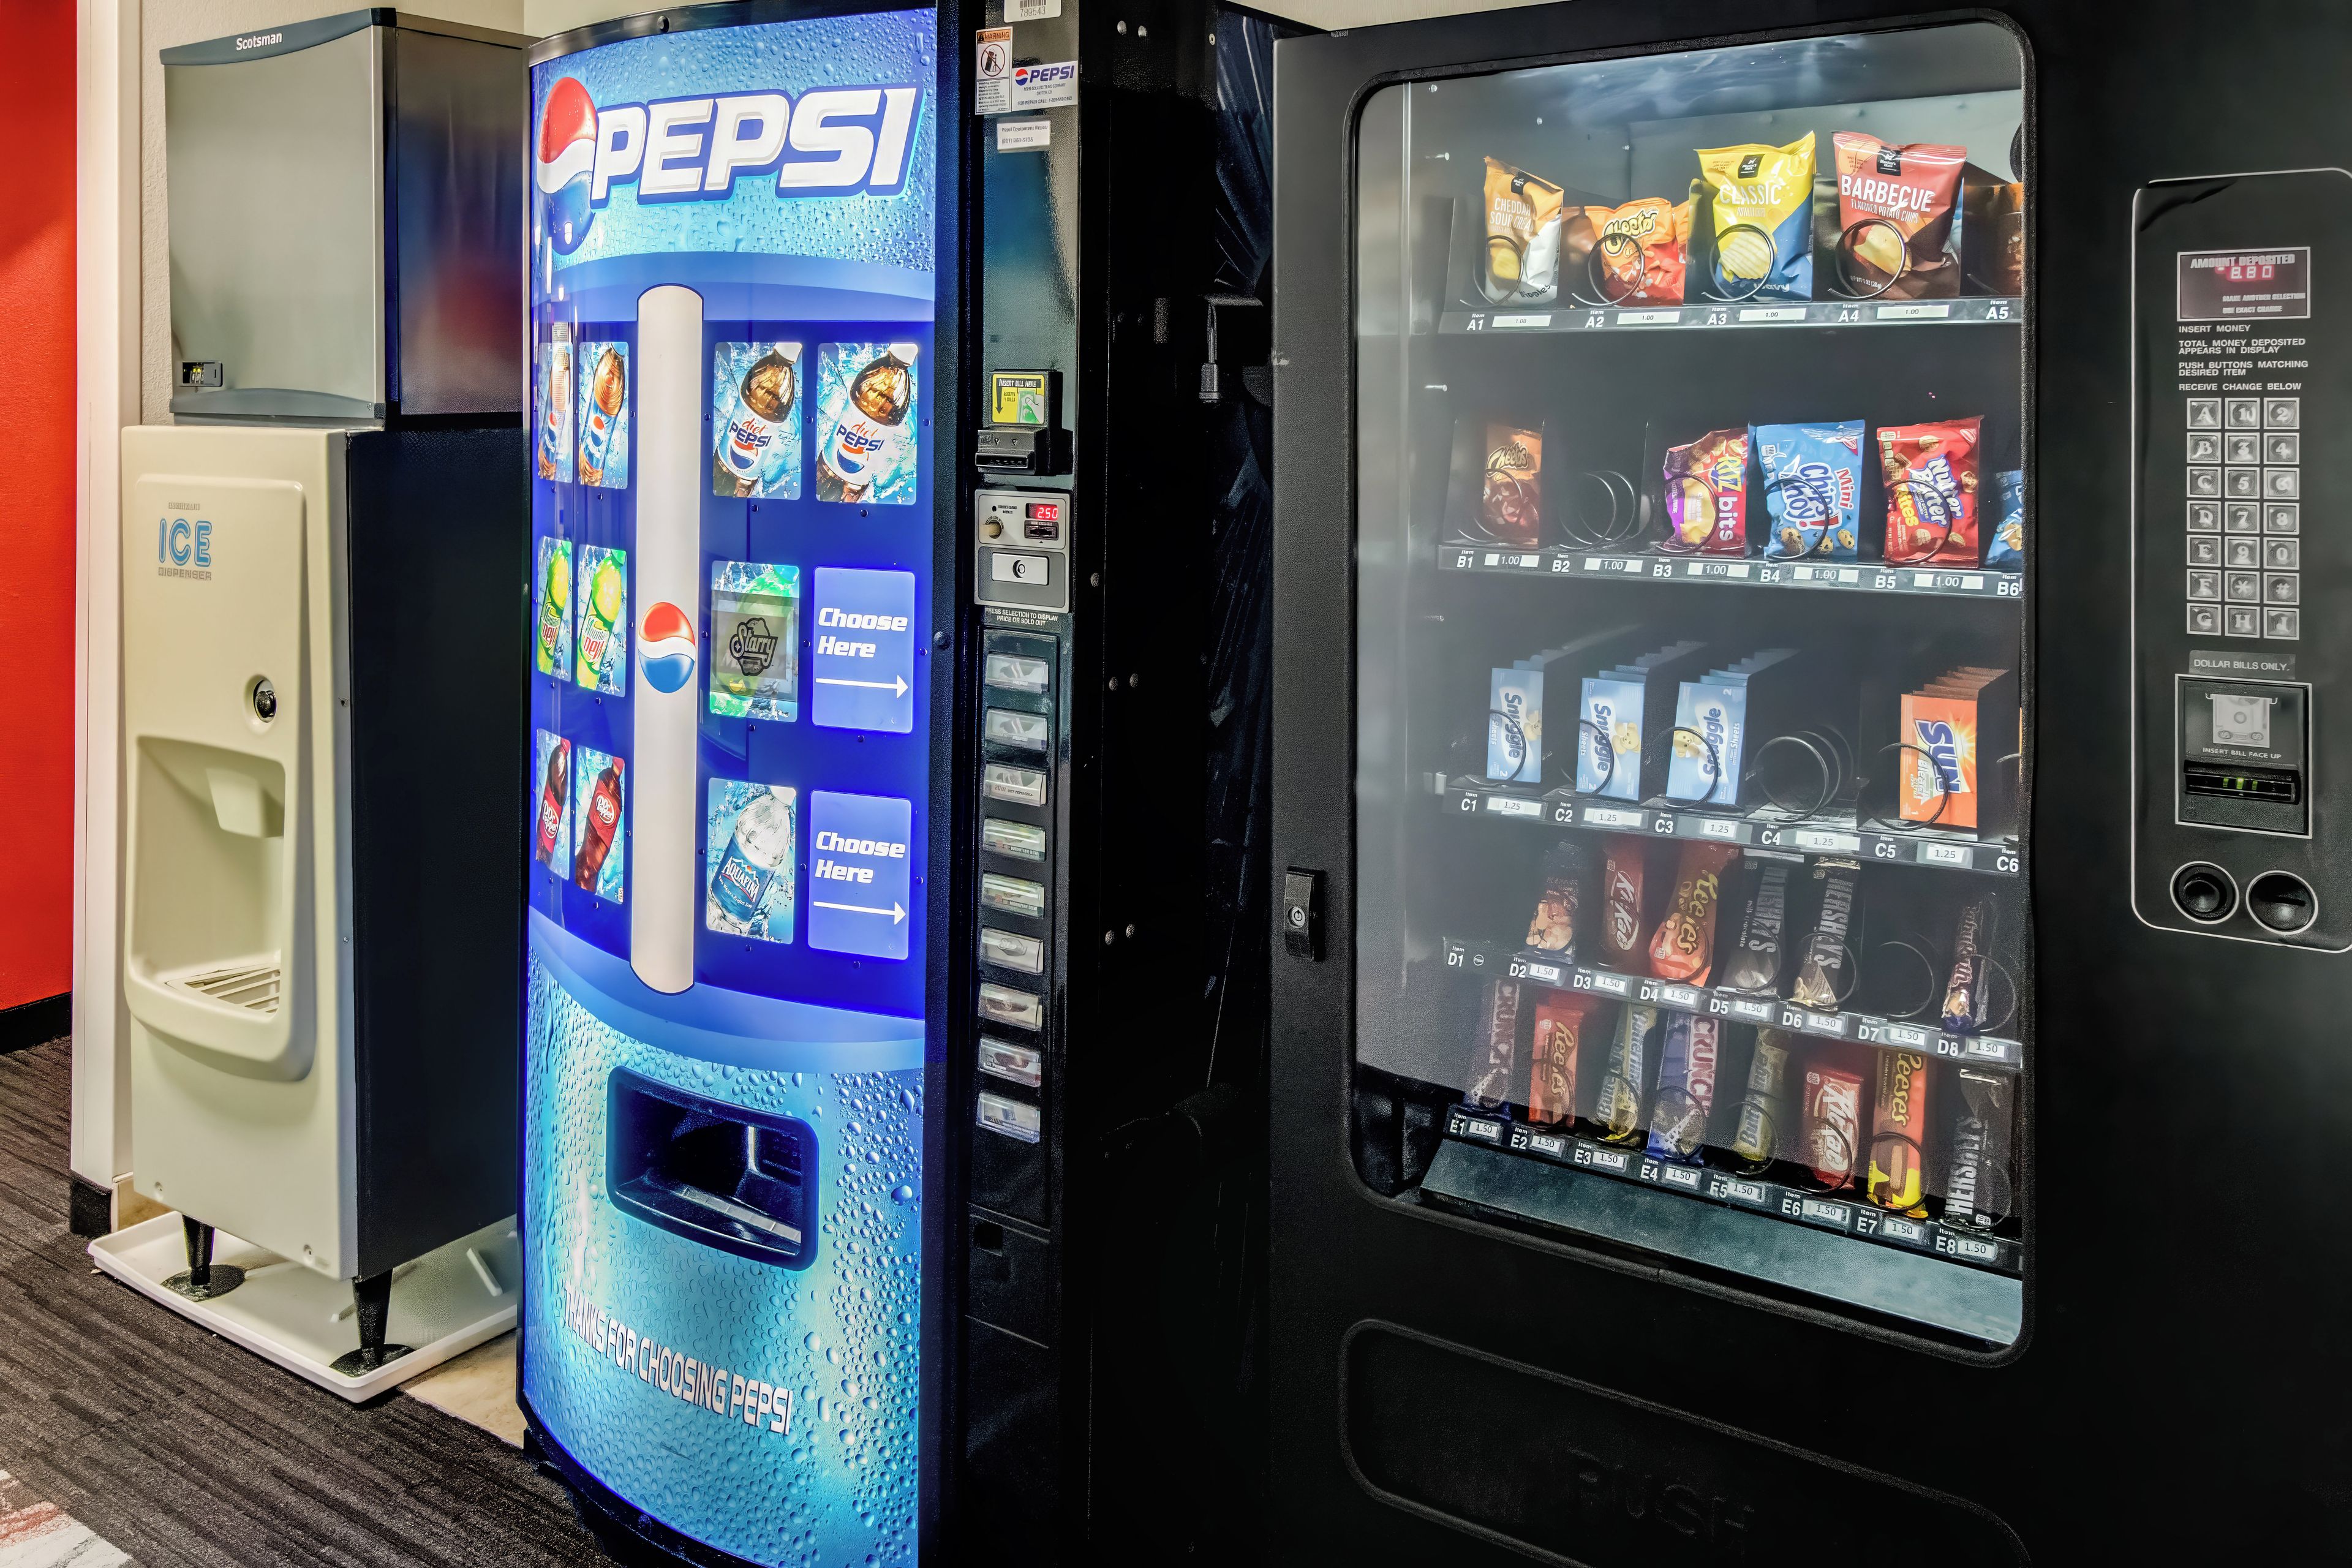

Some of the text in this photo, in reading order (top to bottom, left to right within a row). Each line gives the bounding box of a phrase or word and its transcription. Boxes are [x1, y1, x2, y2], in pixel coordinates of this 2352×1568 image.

[236, 31, 282, 51] Scotsman
[985, 32, 1009, 40] WARNING
[1030, 66, 1074, 83] PEPSI
[590, 86, 920, 206] PEPSI
[1719, 181, 1782, 205] CLASSIC
[1841, 175, 1936, 212] BARBECUE
[1494, 197, 1531, 216] CHEDDAR
[1851, 198, 1919, 224] FLAVORED POTATO CHIPS
[1490, 211, 1513, 227] SOUR
[2190, 254, 2296, 268] AMOUNT DEPOSITED
[1707, 314, 1727, 325] A3
[1838, 309, 1860, 323] A4
[1986, 306, 2009, 320] A5
[1467, 319, 1484, 331] A1
[1585, 317, 1604, 328] A2
[998, 378, 1015, 387] INSERT
[729, 421, 772, 448] PEPSI
[742, 418, 768, 435] diet
[851, 421, 879, 438] diet
[836, 424, 886, 452] PEPSI
[1717, 456, 1743, 493] RITZ
[1800, 464, 1834, 516] Chips
[1836, 468, 1854, 509] Mini
[1910, 467, 1947, 526] Butter
[1928, 459, 1963, 518] Nutter
[1037, 507, 1058, 519] 2.50
[1718, 496, 1738, 541] bits
[159, 518, 213, 568] ICE
[1457, 556, 1520, 568] B1 1.00
[1552, 559, 1623, 573] B2 1.00
[158, 567, 212, 581] DISPENSER
[1653, 565, 1727, 578] B3 1.00
[1760, 570, 1837, 583] B4 1.00
[1875, 575, 1959, 589] B5 1.00
[1997, 581, 2019, 596] B6
[818, 607, 908, 631] Choose
[1002, 609, 1030, 619] SELECTION
[1038, 613, 1058, 622] DISPLAY
[731, 624, 777, 667] Starry
[816, 635, 876, 658] Here
[2193, 659, 2230, 668] DOLLAR
[2233, 660, 2259, 669] BILLS
[1914, 718, 1962, 794] SUN
[1461, 798, 1521, 812] C1 1.25
[1555, 809, 1617, 823] C2 1.25
[1655, 820, 1729, 834] C3 1.25
[815, 831, 907, 859] Choose
[1761, 831, 1834, 846] C4 1.25
[1875, 842, 1956, 859] C5 1.25
[815, 859, 875, 884] Here
[1996, 856, 2019, 872] C6
[1447, 952, 1464, 967] D1
[1509, 963, 1527, 978] D2
[1573, 974, 1620, 990] D3 1.50
[1640, 986, 1689, 1002] D4 1.50
[1709, 998, 1762, 1015] D5 1.50
[1782, 1011, 1836, 1028] D6 1.50
[1858, 1024, 1918, 1042] D7 1.50
[1937, 1039, 1998, 1057] D8 1.50
[1475, 1125, 1493, 1134] 1.50
[1510, 1134, 1555, 1150] E2 1.50
[1574, 1148, 1618, 1165] E3 1.50
[1640, 1166, 1691, 1182] E4 1.50
[1709, 1180, 1753, 1198] E5 1.50
[1782, 1199, 1836, 1217] E6 1.50
[1856, 1216, 1913, 1236] E7 1.50
[1935, 1236, 1987, 1254] E8 1.50
[563, 1287, 794, 1436] THANKS FOR CHOOSING PEPSI
